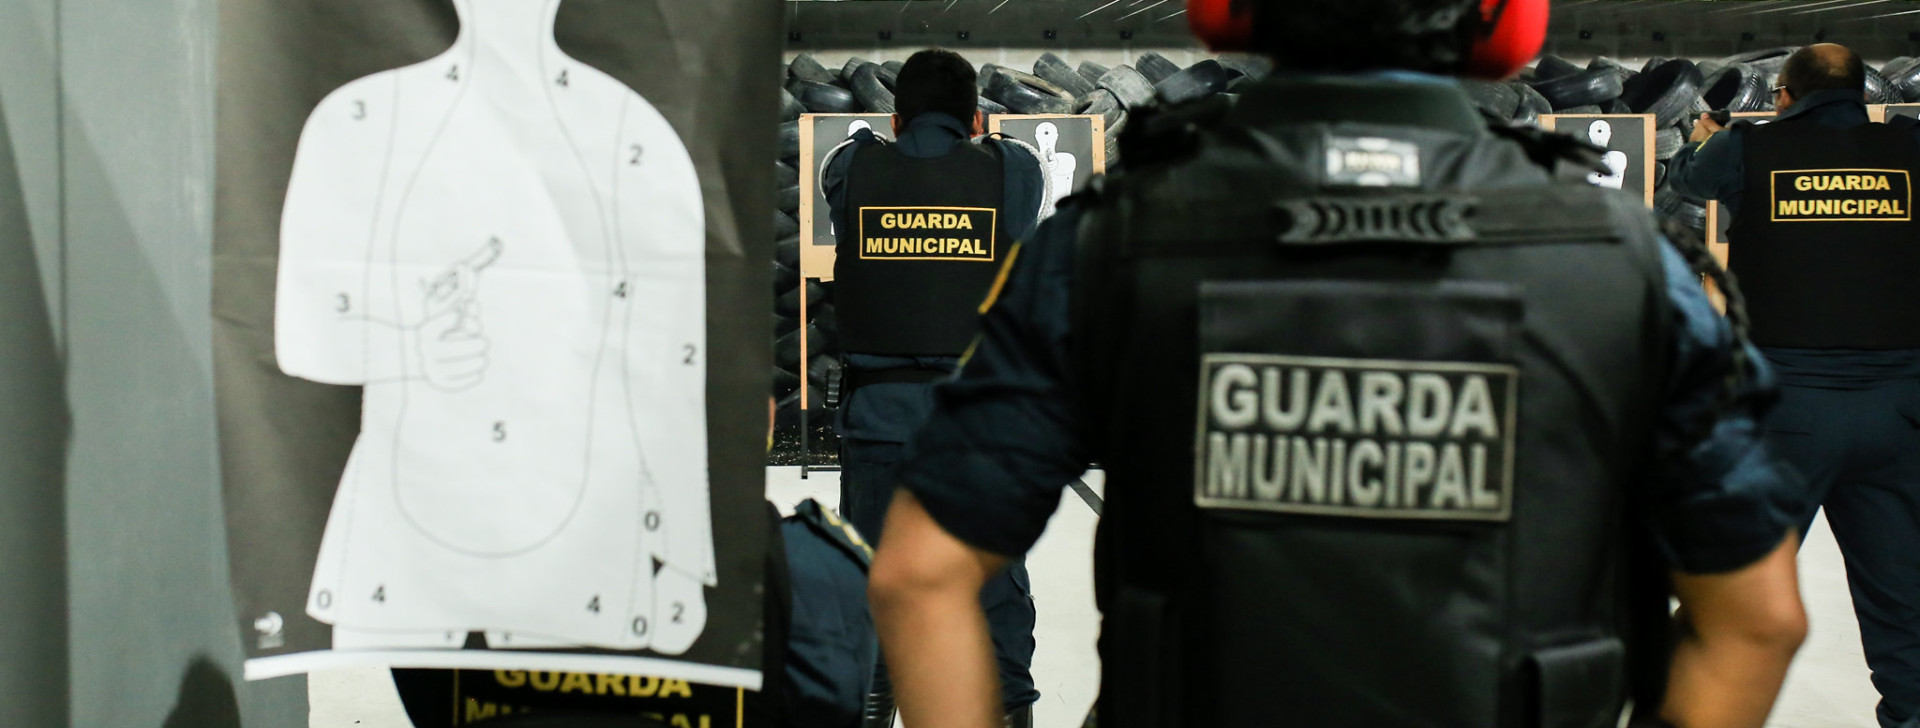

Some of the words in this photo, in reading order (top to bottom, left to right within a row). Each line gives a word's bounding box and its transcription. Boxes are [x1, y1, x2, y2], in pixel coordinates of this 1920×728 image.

[446, 65, 459, 82] 4
[556, 69, 569, 87] 4
[353, 100, 367, 121] 3
[629, 145, 643, 165] 2
[1795, 174, 1891, 192] GUARDA
[1778, 199, 1905, 216] MUNICIPAL
[880, 212, 973, 230] GUARDA
[865, 237, 987, 255] MUNICIPAL
[613, 281, 626, 299] 4
[336, 293, 351, 313] 3
[683, 345, 696, 366] 2
[1210, 363, 1499, 439] GUARDA
[492, 421, 507, 442] 5
[1206, 431, 1499, 509] MUNICIPAL
[644, 511, 660, 531] 0
[316, 589, 332, 610] 0
[371, 585, 385, 604] 4
[587, 595, 600, 614] 4
[671, 603, 684, 623] 2
[632, 616, 648, 636] 0
[494, 668, 693, 698] GUARDA
